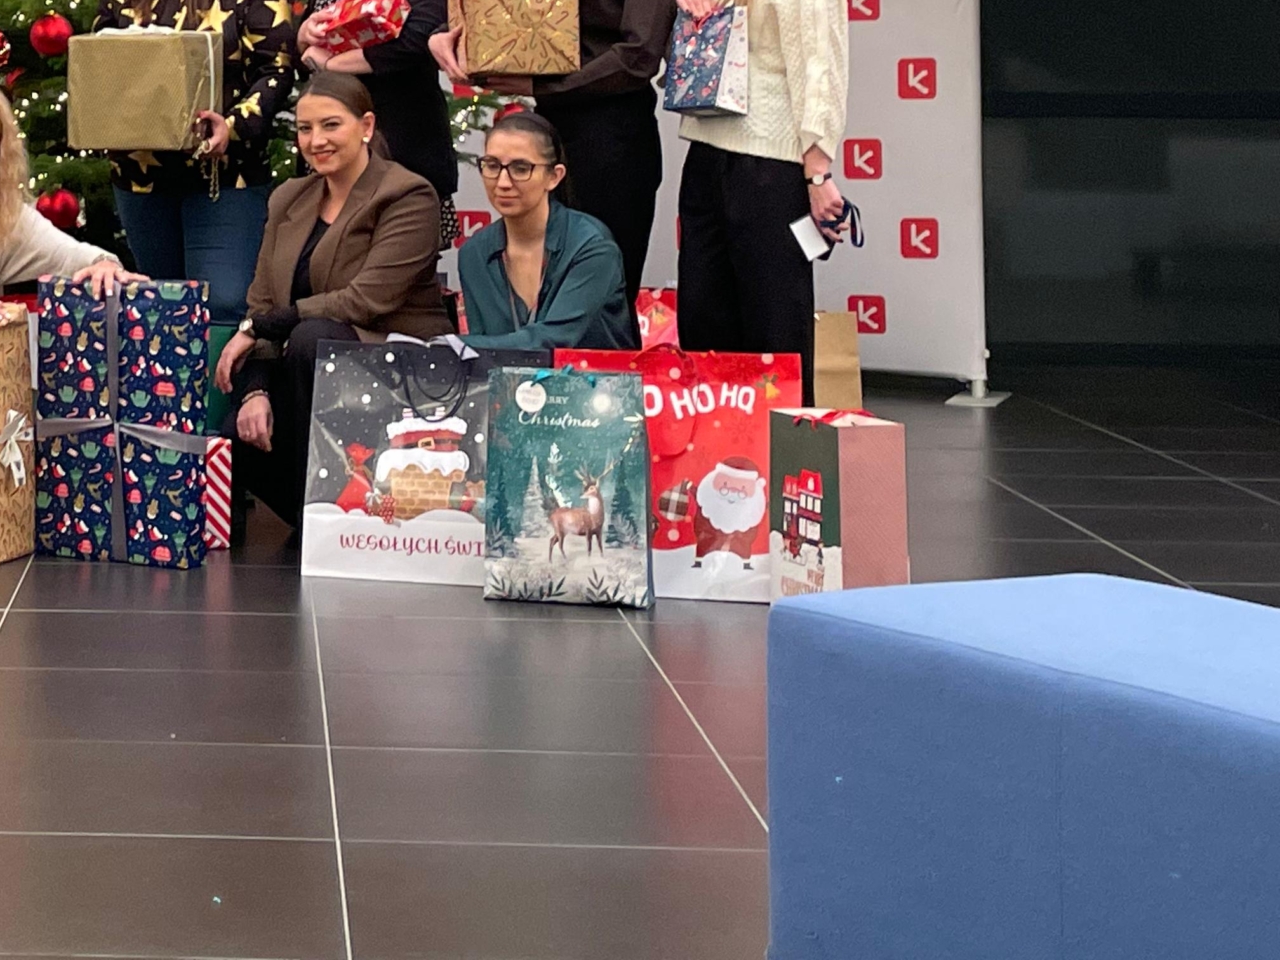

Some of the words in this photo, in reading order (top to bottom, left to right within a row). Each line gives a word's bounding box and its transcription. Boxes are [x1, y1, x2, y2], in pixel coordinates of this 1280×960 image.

[669, 383, 716, 420] HO
[339, 533, 442, 556] WESOŁYCH
[444, 535, 486, 557] ŚWI
